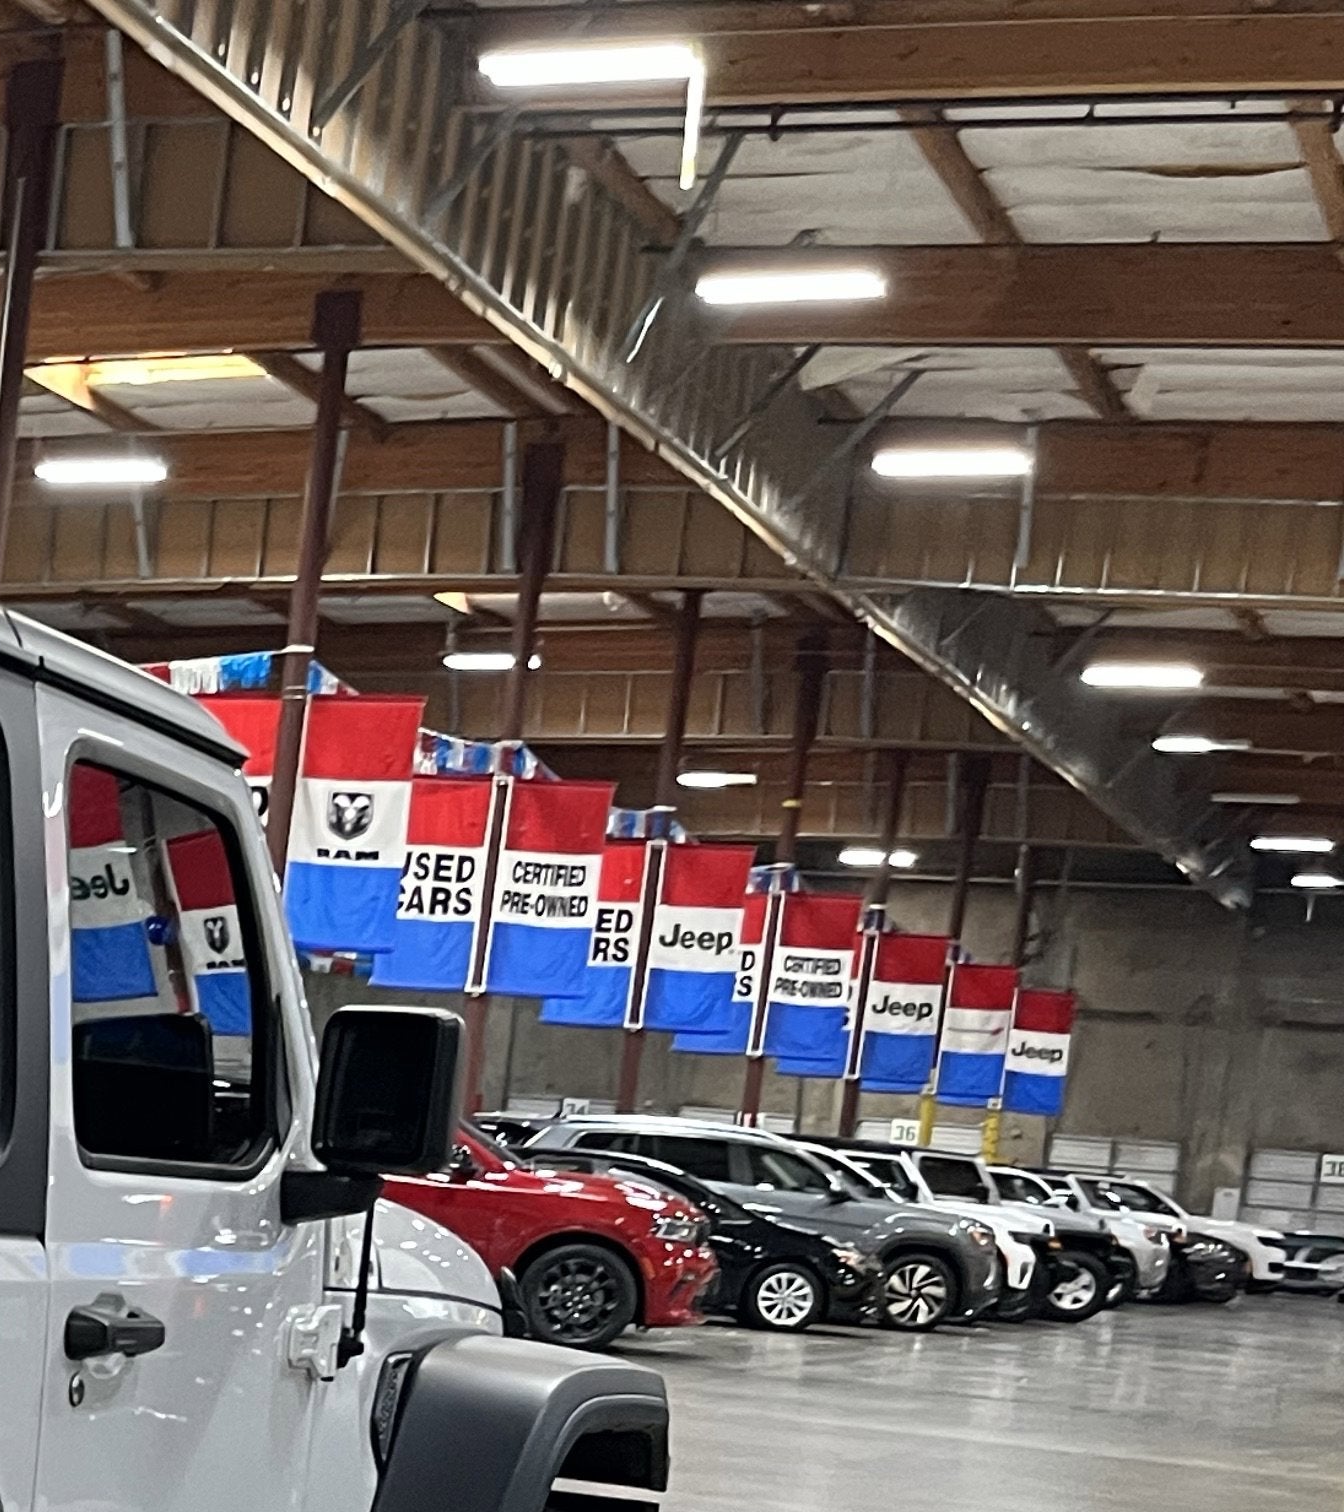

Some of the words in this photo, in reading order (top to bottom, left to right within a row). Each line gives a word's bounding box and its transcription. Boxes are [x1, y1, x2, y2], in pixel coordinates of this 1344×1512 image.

[513, 861, 587, 887] CERTIFIED
[500, 890, 589, 917] PRE-OWNED
[659, 923, 733, 955] Jeep
[872, 995, 933, 1022] Jeep
[1011, 1042, 1063, 1063] Jeep
